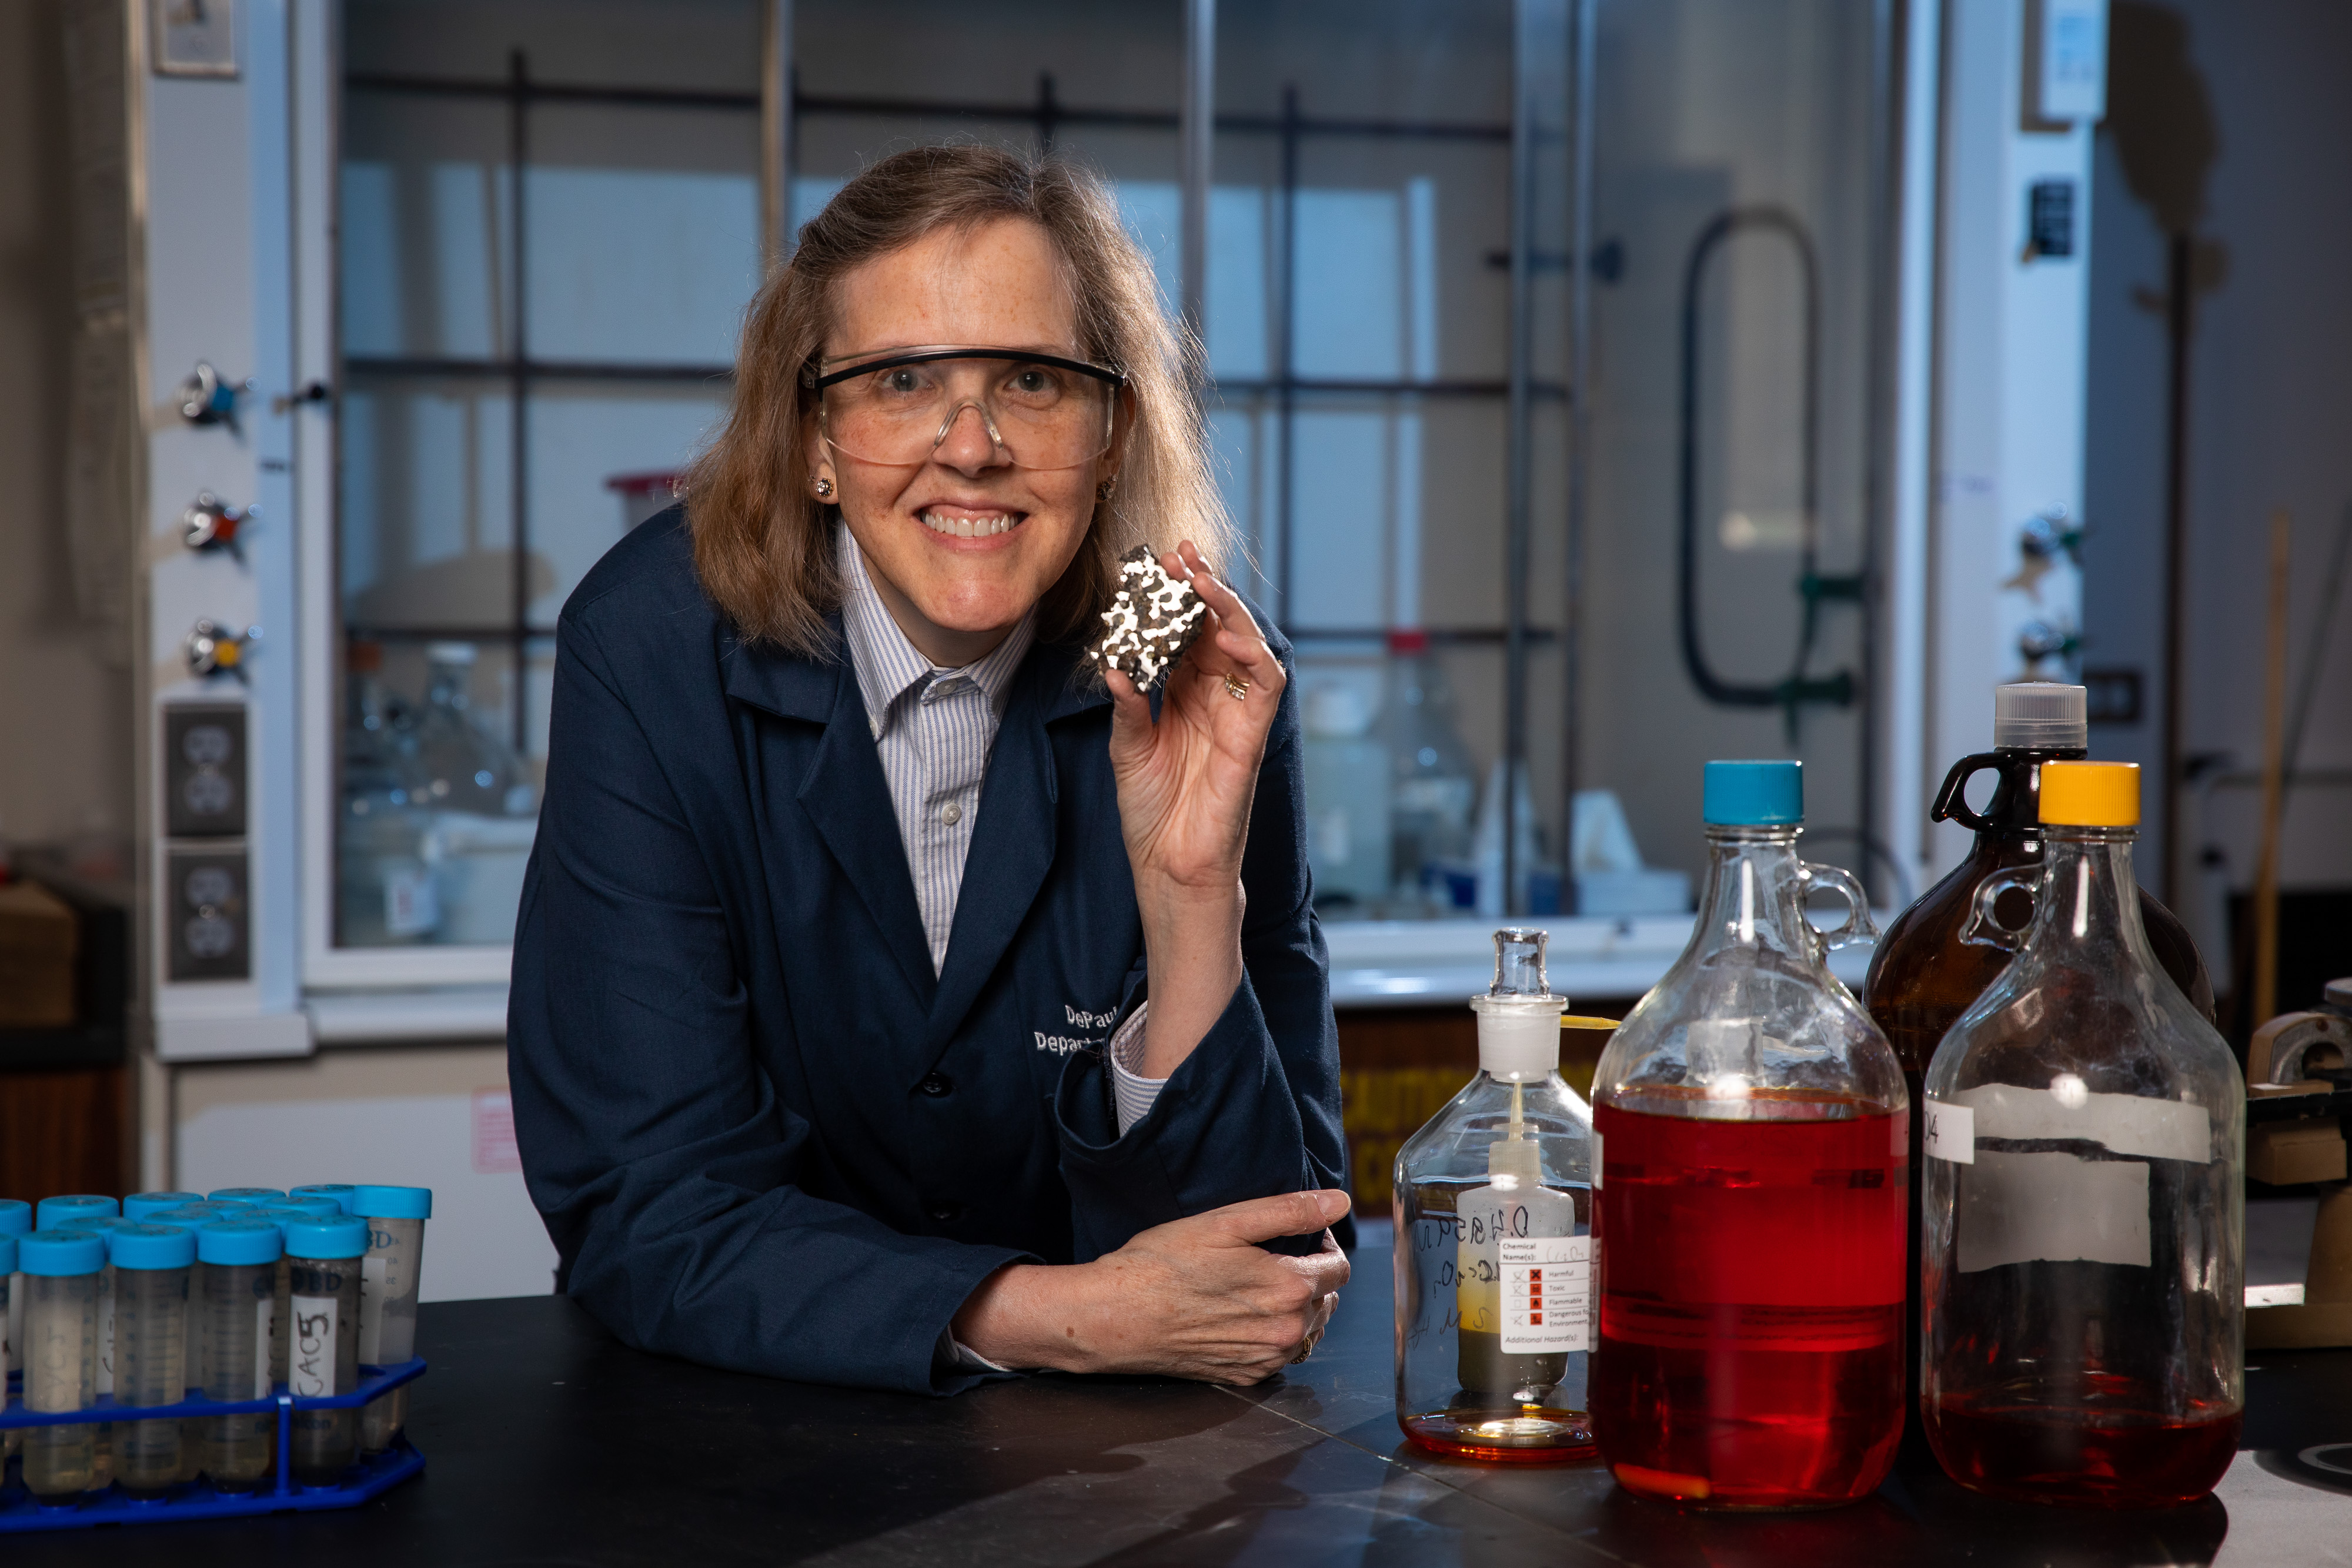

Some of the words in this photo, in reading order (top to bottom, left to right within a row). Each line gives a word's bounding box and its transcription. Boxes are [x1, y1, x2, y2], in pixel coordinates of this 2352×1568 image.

[1034, 1032, 1105, 1056] Depar
[1502, 1253, 1536, 1262] Name(s):
[1548, 1270, 1575, 1278] Harmful
[1549, 1297, 1583, 1306] Flammable
[1549, 1310, 1582, 1319] Dangerous
[1505, 1335, 1543, 1344] Additional
